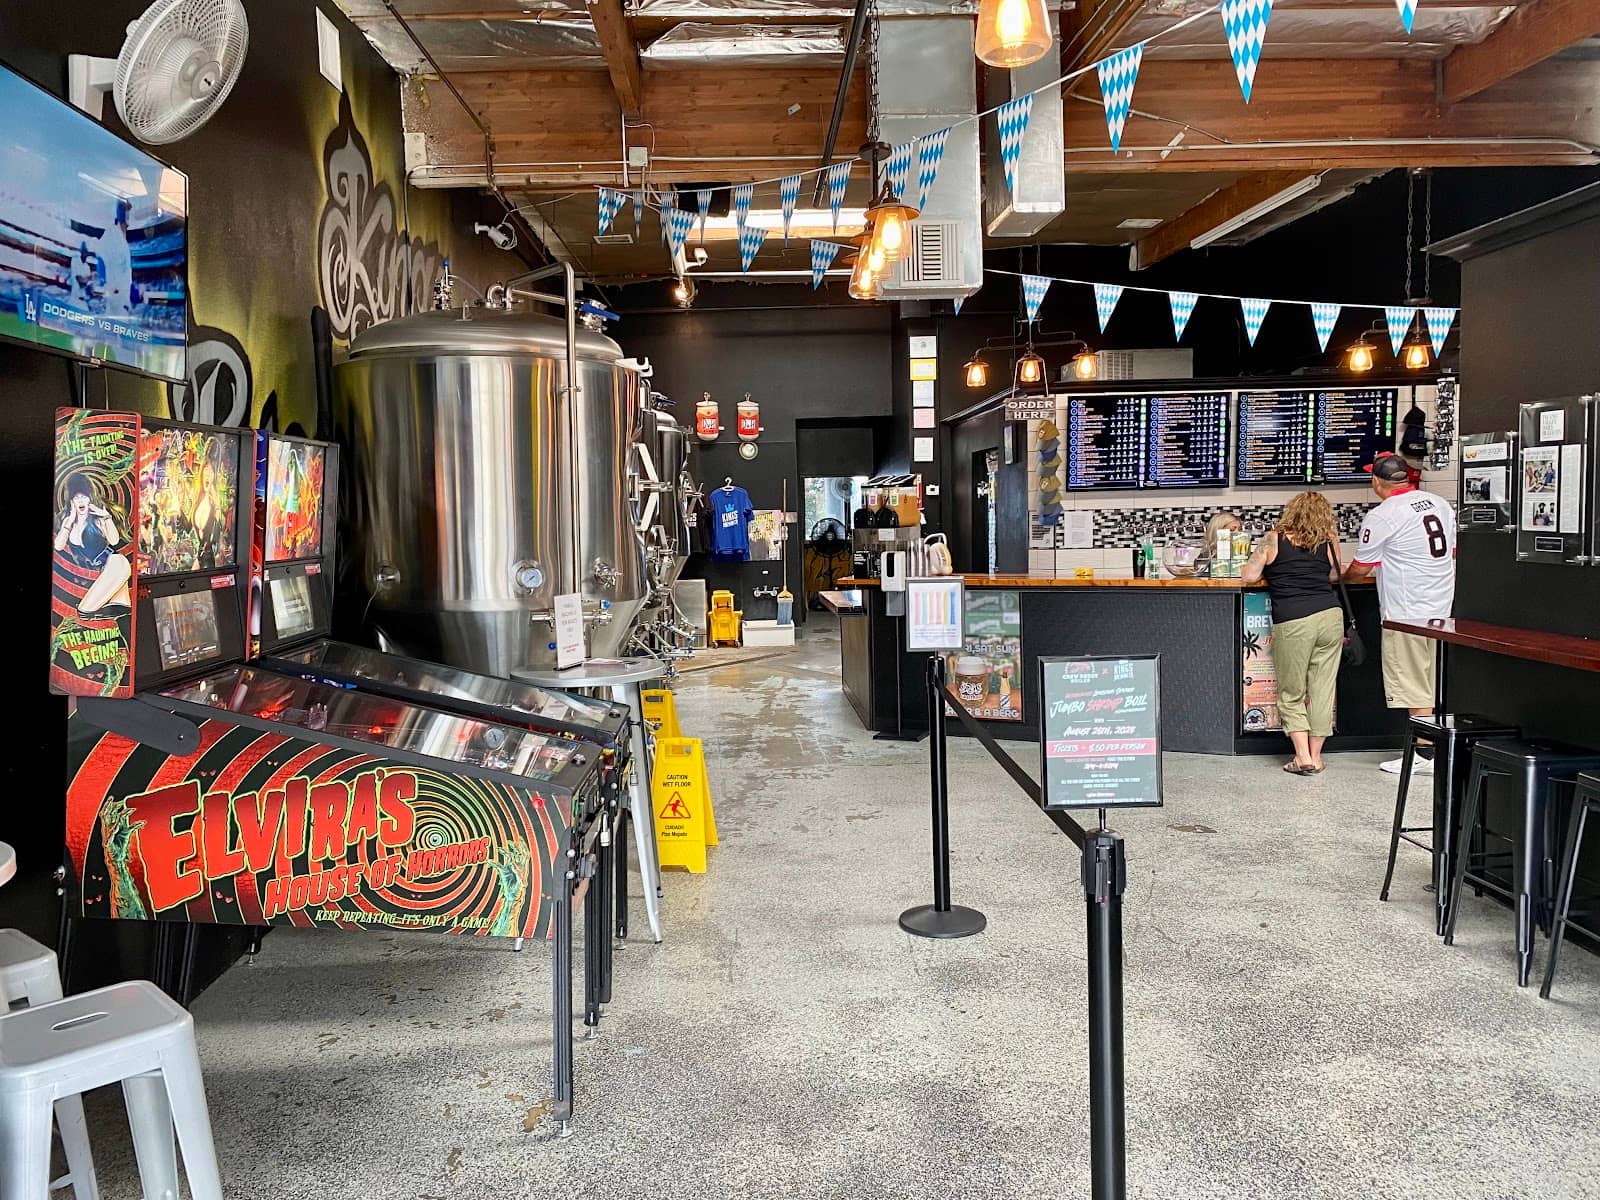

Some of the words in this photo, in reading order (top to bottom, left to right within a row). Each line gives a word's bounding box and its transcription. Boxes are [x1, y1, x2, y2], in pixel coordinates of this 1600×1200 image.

[43, 302, 95, 327] DODGERS
[98, 319, 112, 331] VS
[113, 324, 150, 342] BRAVES
[1008, 401, 1054, 409] ORDER
[1014, 411, 1050, 419] HERE
[62, 438, 86, 457] THE
[89, 429, 125, 448] TAUNTING
[83, 451, 94, 466] IS
[1410, 499, 1436, 513] GREEN
[1362, 528, 1371, 543] 8
[1423, 514, 1447, 558] 8
[1247, 615, 1273, 628] BRE
[59, 631, 83, 649] THE
[83, 626, 120, 644] HAUNTING
[70, 639, 119, 671] BEGINS!
[992, 708, 1019, 718] BERG
[124, 768, 418, 913] ELVIRA'S
[263, 862, 365, 920] HOUSE
[369, 855, 401, 892] OF
[405, 836, 490, 883] HORRORS
[315, 909, 341, 921] KEEP
[422, 914, 449, 926] ONLY
[450, 916, 459, 927] A
